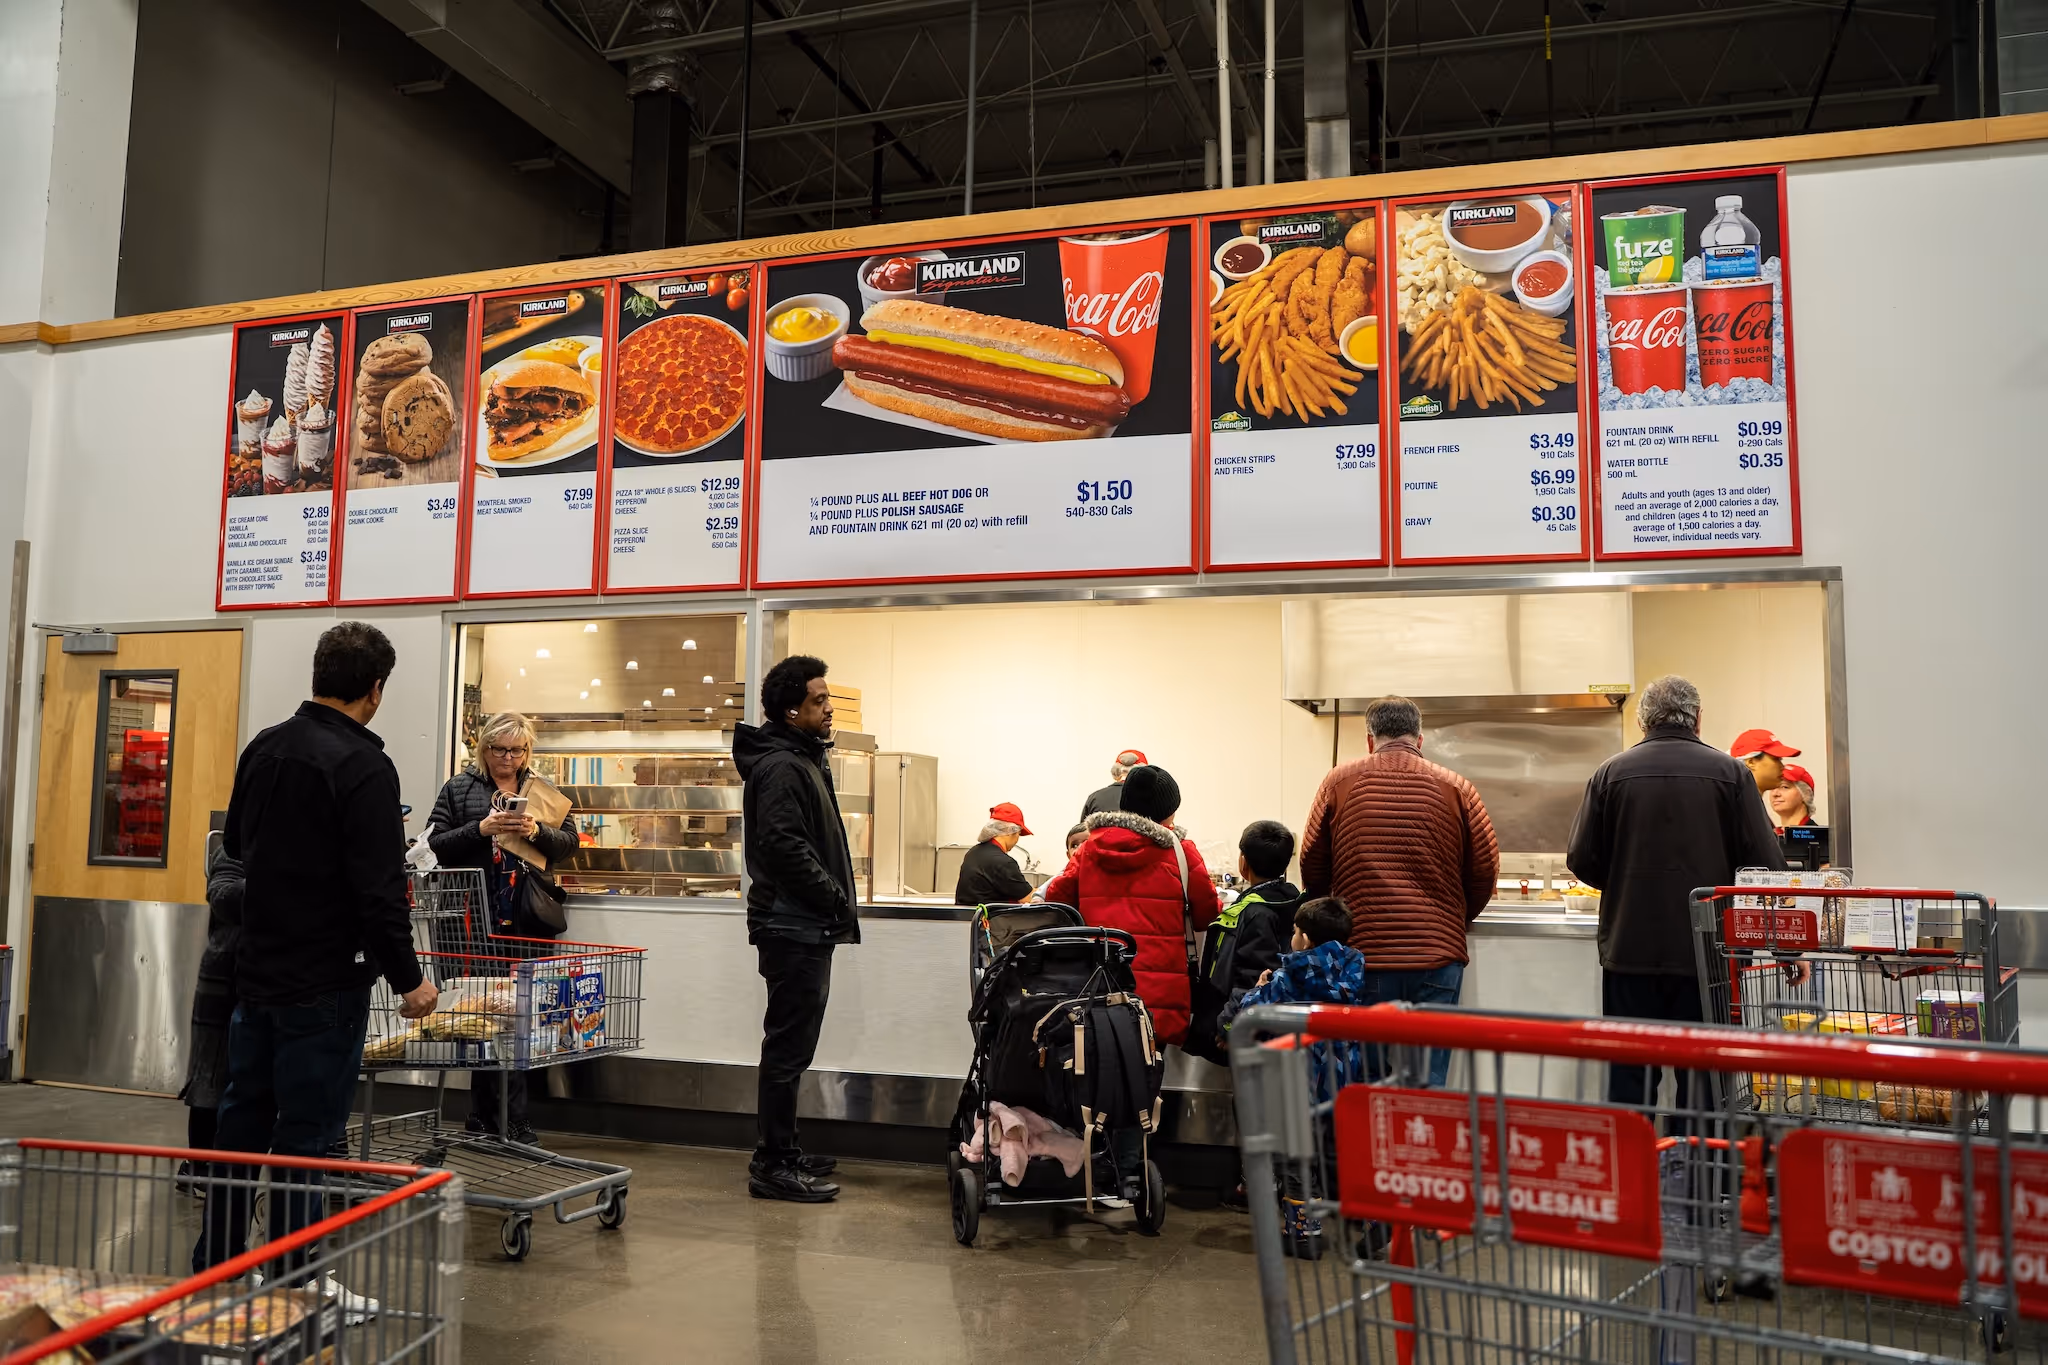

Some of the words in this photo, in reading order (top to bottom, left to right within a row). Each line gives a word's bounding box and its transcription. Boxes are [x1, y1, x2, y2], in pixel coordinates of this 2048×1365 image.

[1453, 207, 1514, 220] KIRKLAND
[1262, 223, 1320, 237] KIRKLAND
[1614, 236, 1673, 260] fuze
[922, 257, 1020, 280] KIRKLAND
[661, 283, 707, 295] KIRKLAND
[922, 276, 1020, 292] Signature
[523, 300, 565, 312] KIRKLAND
[391, 316, 429, 327] KIRKLAND
[272, 331, 308, 341] KIRKLAND
[1734, 346, 1769, 354] SUGAR
[1703, 357, 1730, 365] ZÉRO
[1735, 356, 1769, 364] SUCRE
[1402, 404, 1438, 414] Cavendish
[1214, 420, 1248, 429] Cavendish
[1606, 427, 1645, 436] FOUNTAIN
[1648, 425, 1673, 434] DRINK
[1738, 420, 1781, 438] $0.99
[1530, 432, 1573, 450] $3.49
[1606, 439, 1620, 447] 621
[1623, 438, 1636, 446] mL
[1638, 437, 1651, 447] (20
[1653, 437, 1665, 446] oz)
[1667, 435, 1689, 444] WITH
[1691, 434, 1719, 443] REFILL
[1738, 438, 1762, 447] 0-290
[1765, 438, 1782, 446] Cals
[1335, 443, 1375, 460] $7.99
[1404, 446, 1434, 454] FRENCH
[1437, 444, 1459, 453] FRIES
[1540, 451, 1554, 459] 910
[1557, 450, 1574, 458] Cals
[1214, 456, 1246, 465] CHICKEN
[1248, 454, 1275, 463] STRIPS
[1337, 461, 1357, 469] 1,300
[1359, 460, 1375, 468] Cals
[1607, 459, 1634, 467] WATER
[1637, 457, 1668, 466] BOTTLE
[1739, 452, 1783, 470] $0.35
[1214, 467, 1230, 475] AND
[1232, 466, 1253, 474] FRIES
[1607, 470, 1622, 478] 500
[1625, 469, 1637, 477] mL
[1531, 469, 1574, 486] $6.99
[674, 485, 696, 493] SLICES)
[701, 477, 739, 492] $12.99
[1404, 481, 1437, 490] POUTINE
[564, 487, 592, 502] $7.99
[708, 492, 725, 500] 4,020
[821, 495, 852, 506] POUND
[855, 493, 878, 504] PLUS
[881, 492, 899, 502] ALL
[902, 490, 926, 501] BEEF
[929, 489, 949, 499] HOT
[952, 488, 972, 498] DOG
[975, 487, 988, 497] OR
[1077, 479, 1132, 504] $1.50
[1535, 487, 1555, 496] 1,950
[1558, 486, 1575, 494] Cals
[1621, 491, 1647, 499] Adults
[1649, 490, 1664, 498] and
[1667, 489, 1689, 499] youth
[1692, 489, 1714, 498] (ages
[1717, 487, 1726, 495] 13
[1729, 487, 1744, 495] and
[1746, 486, 1770, 495] older)
[427, 497, 455, 511] $3.49
[615, 497, 647, 505] PEPPERONI
[1614, 502, 1634, 510] need
[1649, 501, 1681, 510] average
[1683, 499, 1691, 508] of
[1694, 499, 1717, 508] 2,000
[1719, 498, 1751, 506] calories
[1762, 497, 1778, 506] day,
[302, 506, 329, 519] $2.89
[348, 508, 367, 516] DOUBLE
[368, 506, 398, 515] CHOCOLATE
[493, 506, 522, 514] SANDWICH
[614, 506, 636, 514] CHEESE
[821, 509, 851, 520] POUND
[855, 507, 878, 518] PLUS
[881, 505, 915, 516] POLISH
[918, 503, 963, 515] SAUSAGE
[1065, 505, 1107, 517] 540-830
[1111, 504, 1132, 515] Cals
[1532, 505, 1575, 522] $0.30
[1625, 513, 1640, 521] and
[1642, 512, 1675, 520] children
[1678, 512, 1700, 520] (ages
[1702, 510, 1707, 518] 4
[1721, 509, 1732, 518] 12)
[1735, 508, 1755, 516] need
[348, 517, 365, 525] CHUNK
[705, 516, 738, 531] $2.59
[809, 525, 828, 535] AND
[831, 522, 876, 533] FOUNTAIN
[879, 520, 908, 531] DRINK
[911, 519, 926, 530] 621
[931, 519, 943, 529] ml
[946, 518, 961, 530] (20
[964, 517, 978, 529] oz)
[981, 516, 1002, 526] with
[1006, 515, 1027, 525] refill
[1405, 517, 1431, 526] GRAVY
[1546, 523, 1556, 531] 45
[1559, 523, 1576, 531] Cals
[1633, 524, 1664, 532] average
[1667, 522, 1675, 530] of
[1678, 521, 1699, 531] 1,500
[1702, 520, 1734, 529] calories
[1744, 519, 1761, 529] day.
[1672, 532, 1711, 541] individual
[1714, 531, 1739, 539] needs
[1741, 532, 1761, 540] vary.
[300, 550, 326, 563] $3.49
[1375, 1170, 1466, 1203] COSTCO
[1828, 1229, 1952, 1270] COSTCO
